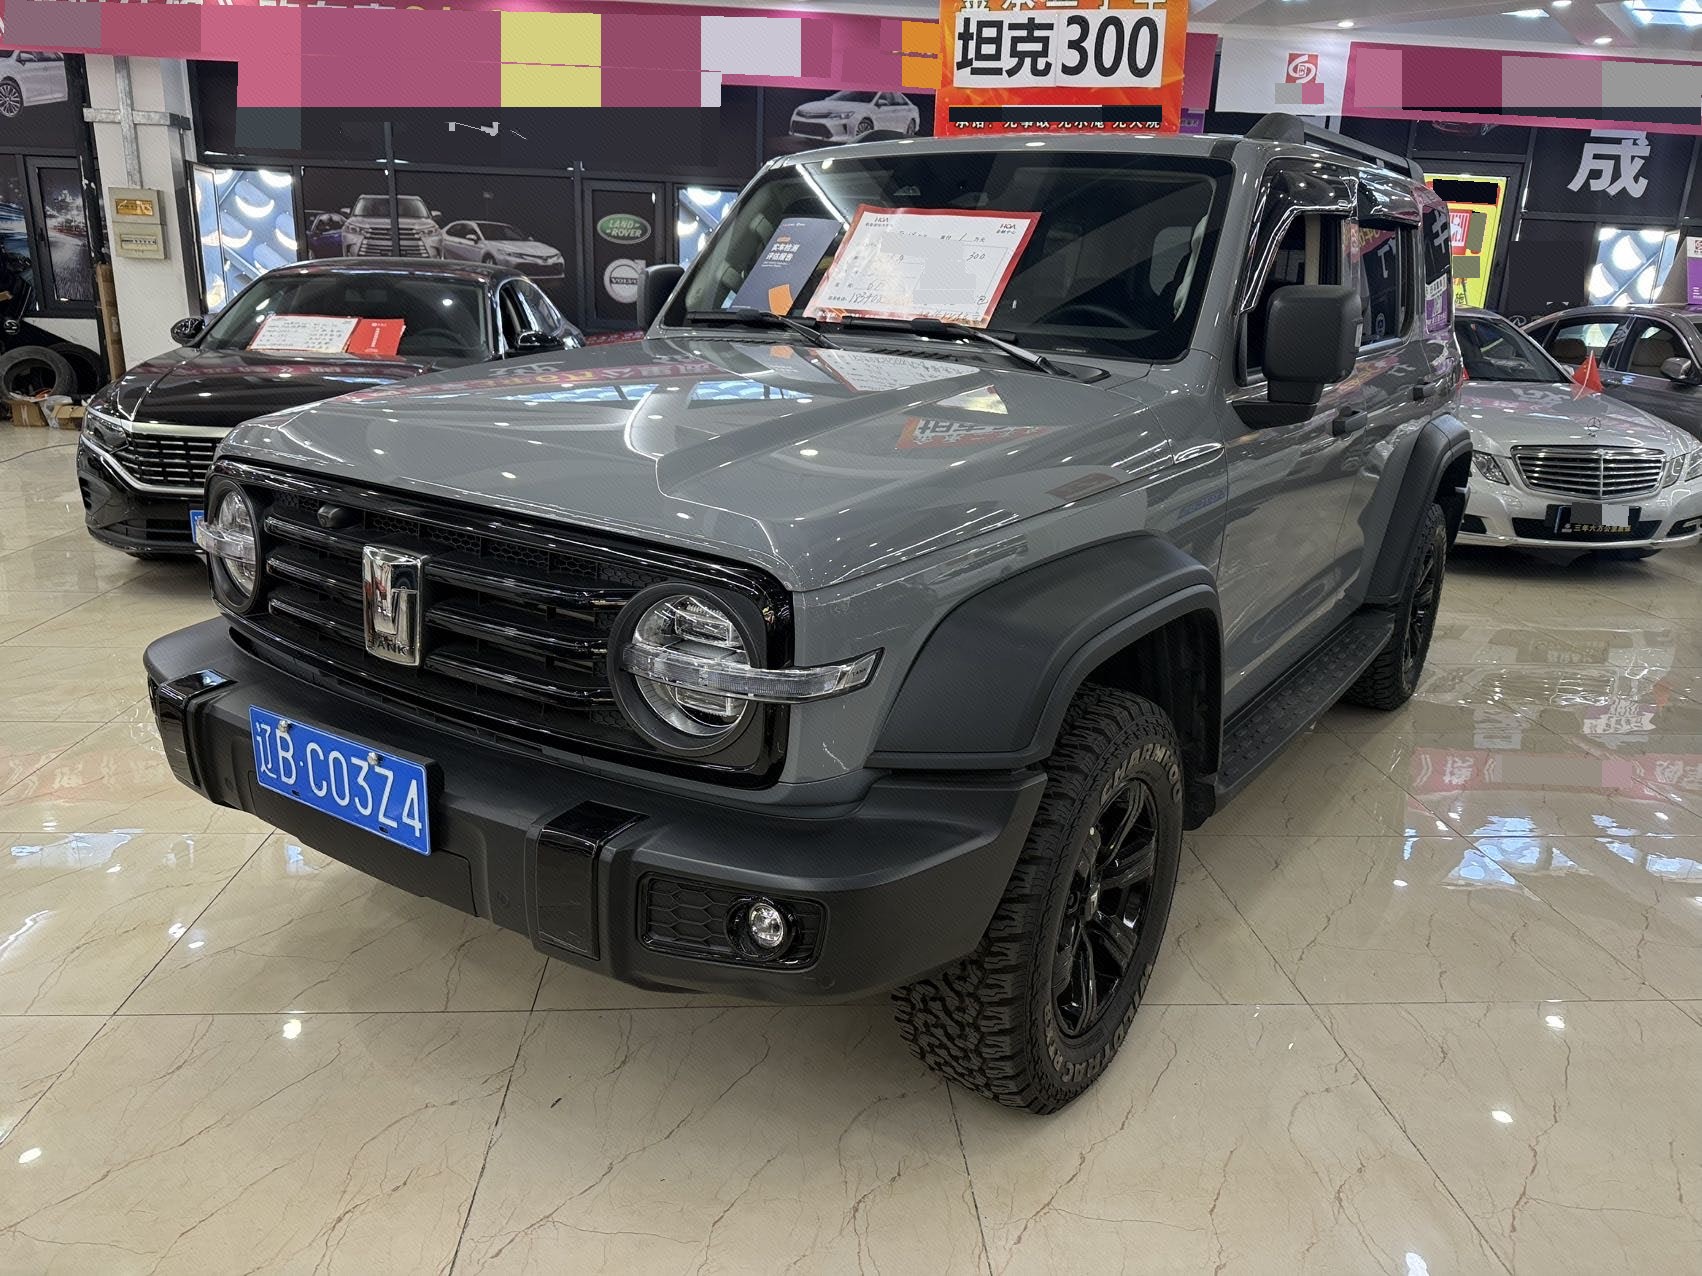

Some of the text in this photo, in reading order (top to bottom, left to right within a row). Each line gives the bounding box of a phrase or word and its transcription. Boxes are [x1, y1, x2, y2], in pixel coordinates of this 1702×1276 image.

[956, 14, 1159, 79] 坦克300
[609, 220, 634, 228] LAND
[611, 228, 642, 237] ROVER
